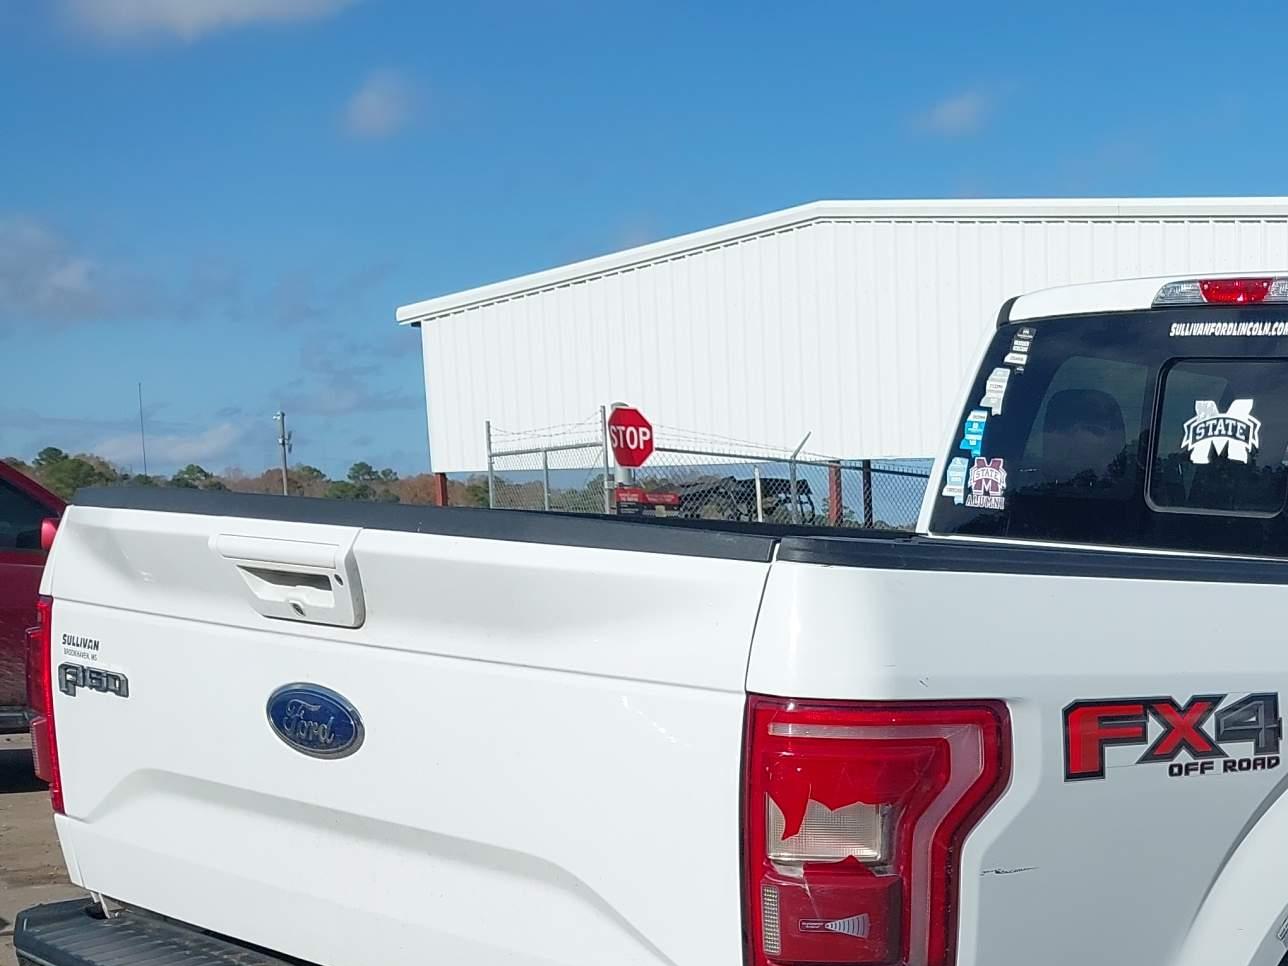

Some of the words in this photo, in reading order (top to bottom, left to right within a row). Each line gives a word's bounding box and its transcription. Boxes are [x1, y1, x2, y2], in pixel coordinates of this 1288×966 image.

[609, 425, 651, 449] STOP
[1195, 418, 1247, 440] STATE
[975, 468, 1000, 481] STATE
[966, 494, 1006, 510] ALUMNI
[62, 633, 100, 651] SULLIVAN
[282, 697, 336, 746] Ford
[1062, 692, 1283, 782] FX4
[1168, 761, 1215, 778] OFF
[1222, 755, 1281, 773] ROAD
